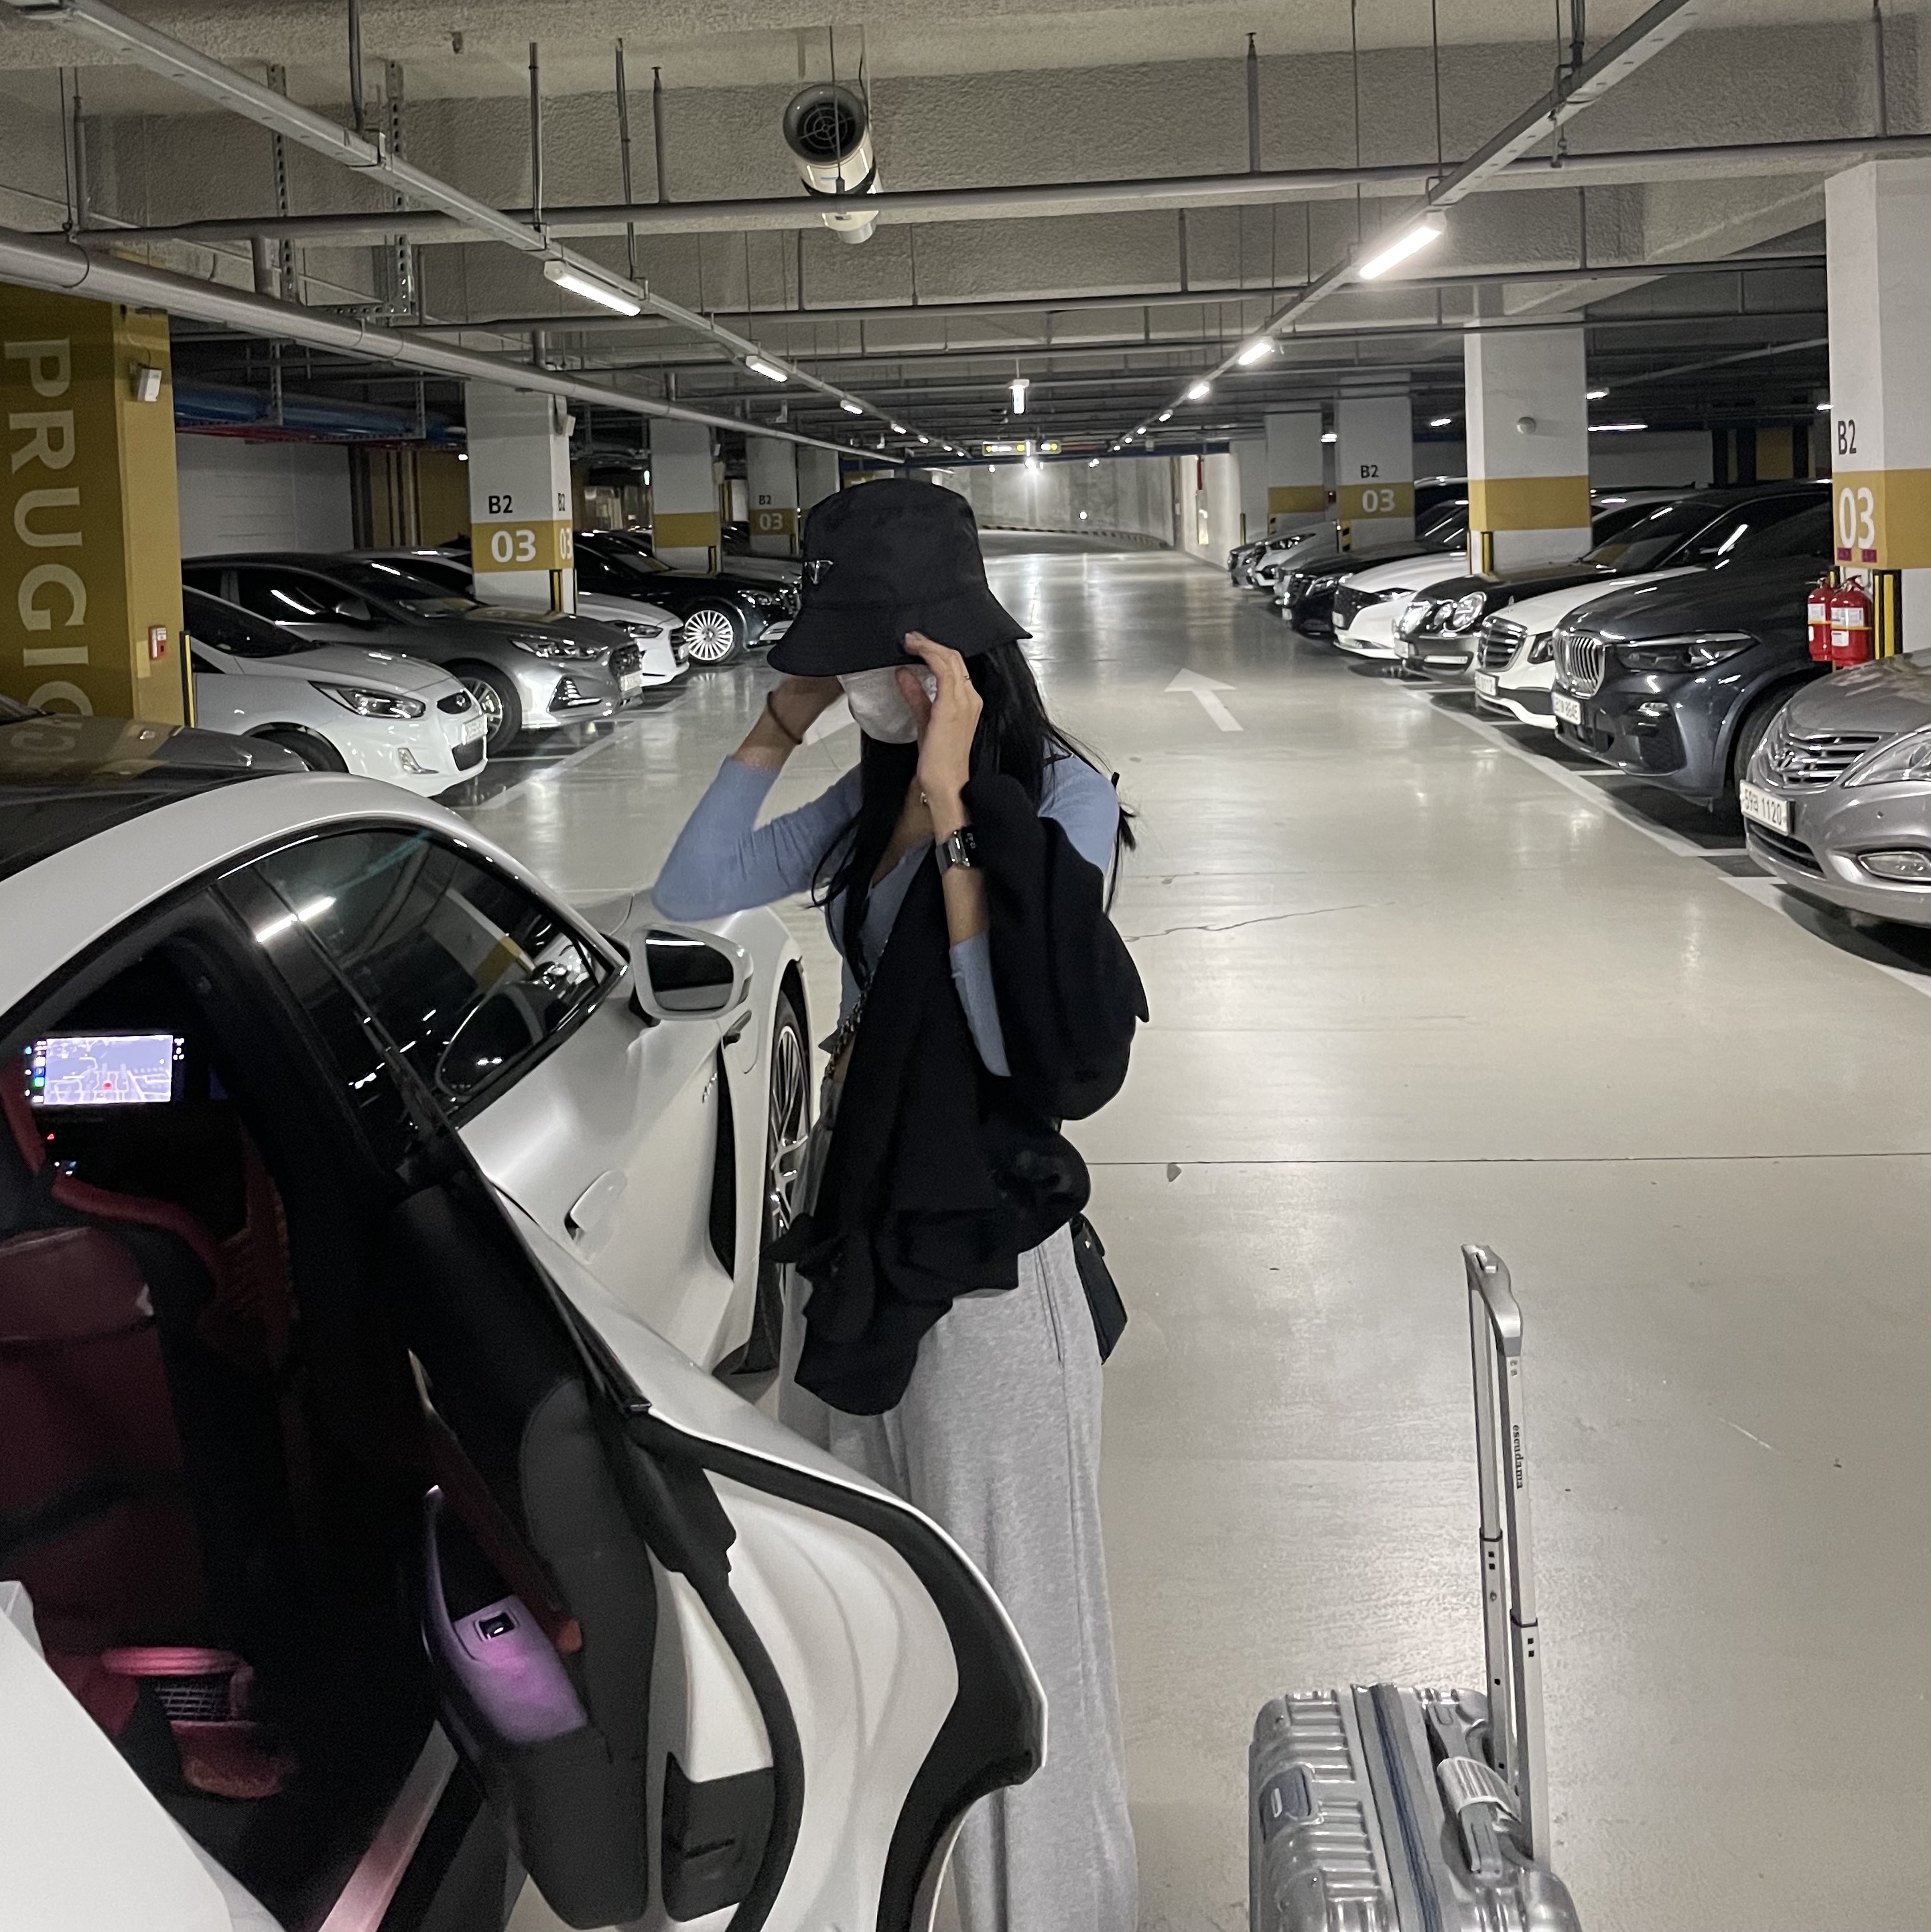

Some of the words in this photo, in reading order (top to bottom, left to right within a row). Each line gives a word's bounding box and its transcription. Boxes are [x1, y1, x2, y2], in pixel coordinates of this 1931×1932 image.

[1838, 419, 1857, 456] B2
[1360, 464, 1380, 478] B2
[488, 495, 513, 515] B2
[558, 493, 565, 512] B2
[758, 495, 772, 505] B2
[1361, 489, 1396, 513] 03
[760, 513, 783, 531] 03
[1839, 487, 1876, 550] 03
[490, 529, 537, 564] 03
[559, 527, 573, 560] 03
[1761, 797, 1782, 826] 1120
[1512, 1424, 1524, 1490] escudama
